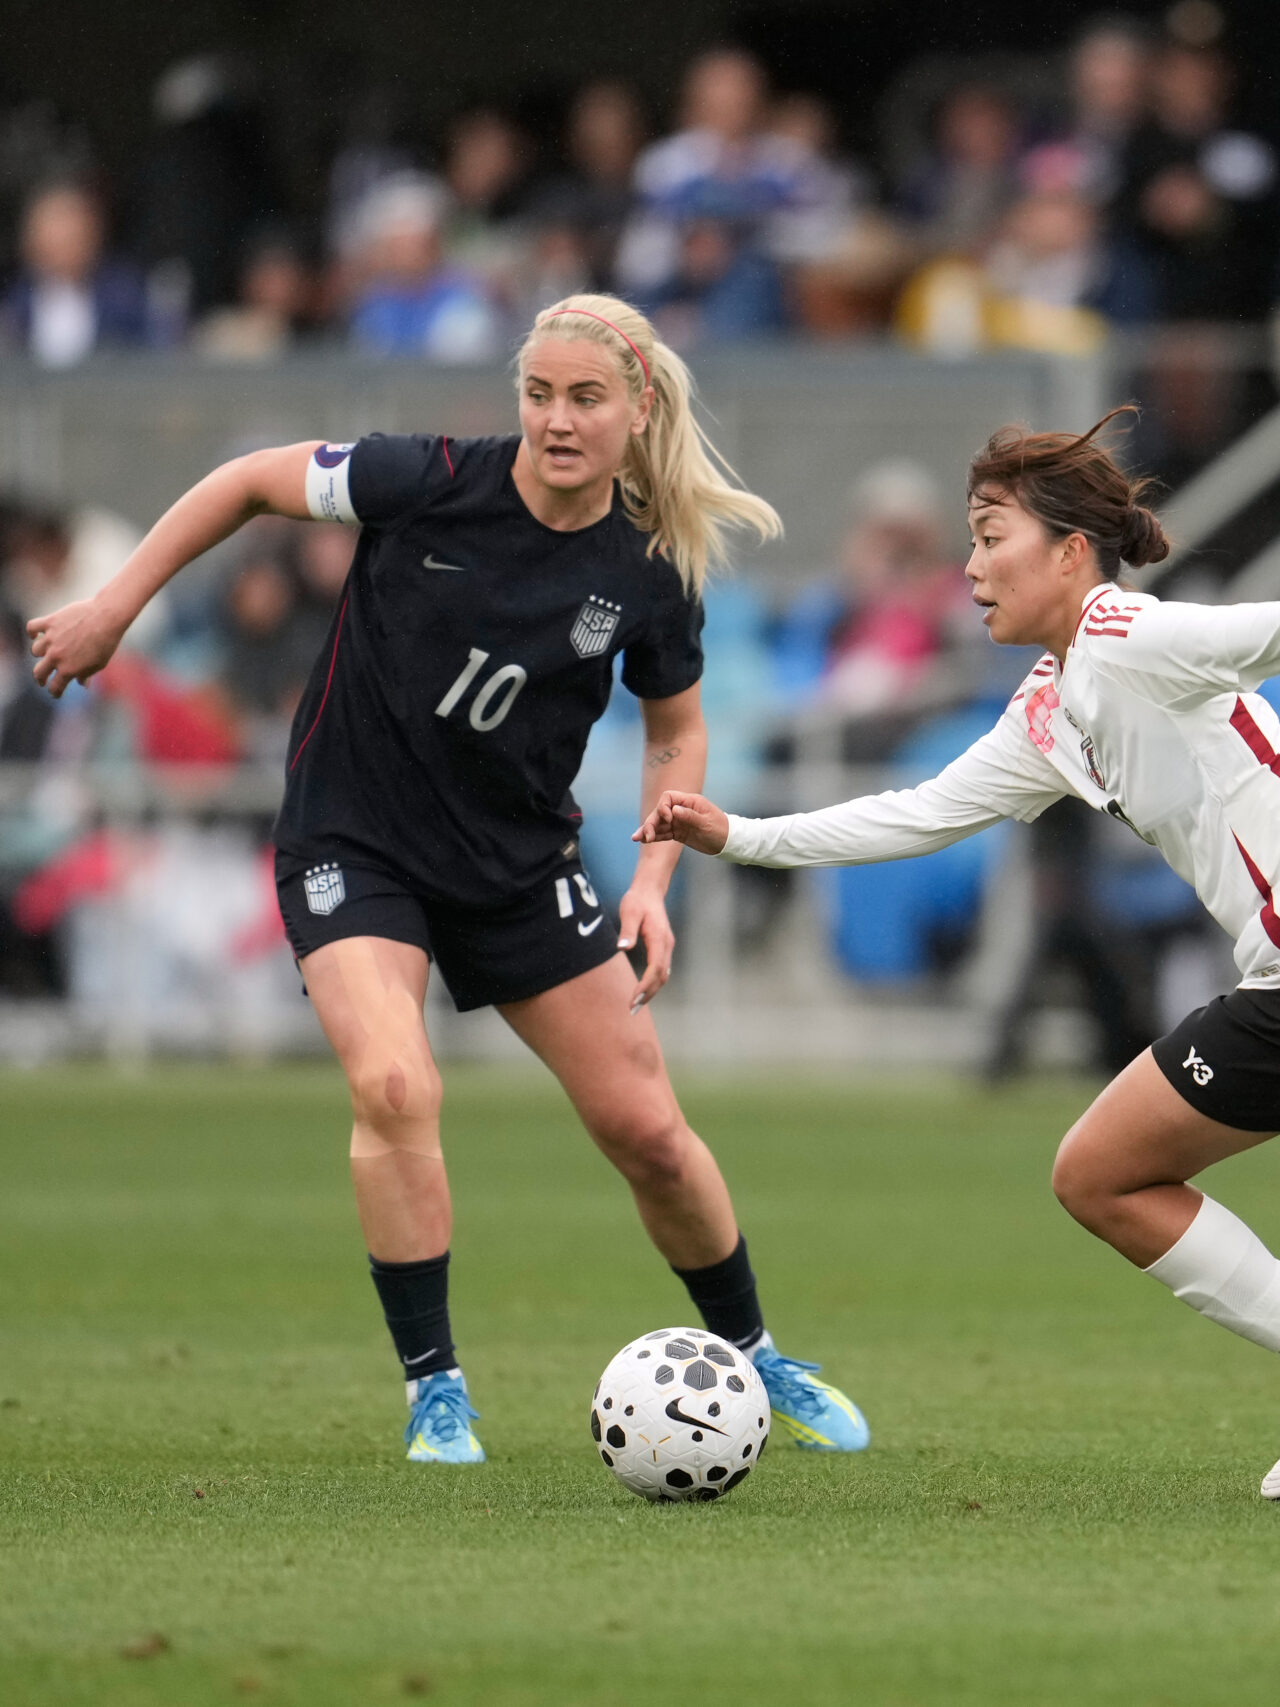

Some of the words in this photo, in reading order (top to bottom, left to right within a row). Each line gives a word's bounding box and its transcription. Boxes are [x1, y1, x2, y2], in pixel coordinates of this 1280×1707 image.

[582, 607, 615, 631] USA
[434, 647, 528, 733] 10
[307, 872, 340, 892] USA
